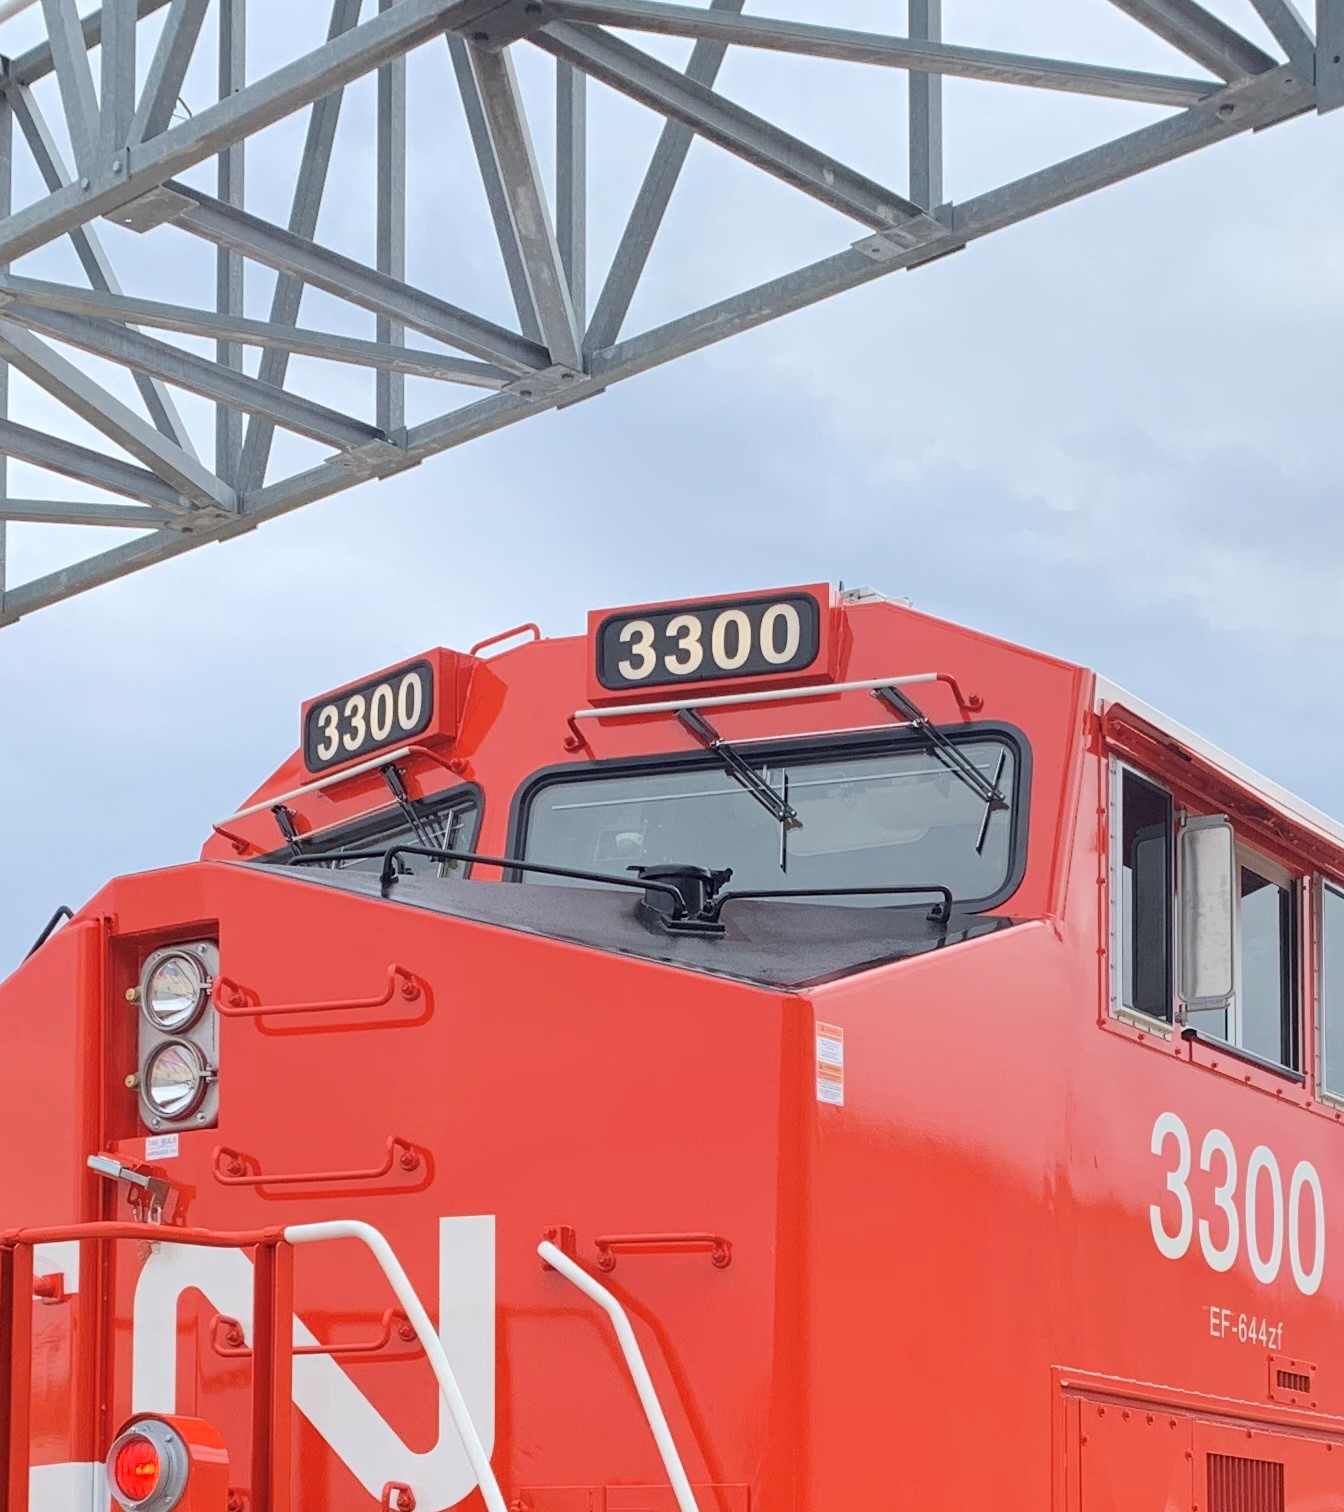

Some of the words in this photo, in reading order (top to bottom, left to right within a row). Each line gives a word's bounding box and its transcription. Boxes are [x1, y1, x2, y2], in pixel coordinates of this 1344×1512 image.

[618, 604, 800, 680] 3300
[317, 672, 422, 761] 3300
[1150, 1111, 1325, 1296] 3300
[1209, 1306, 1284, 1350] EF-644zf
